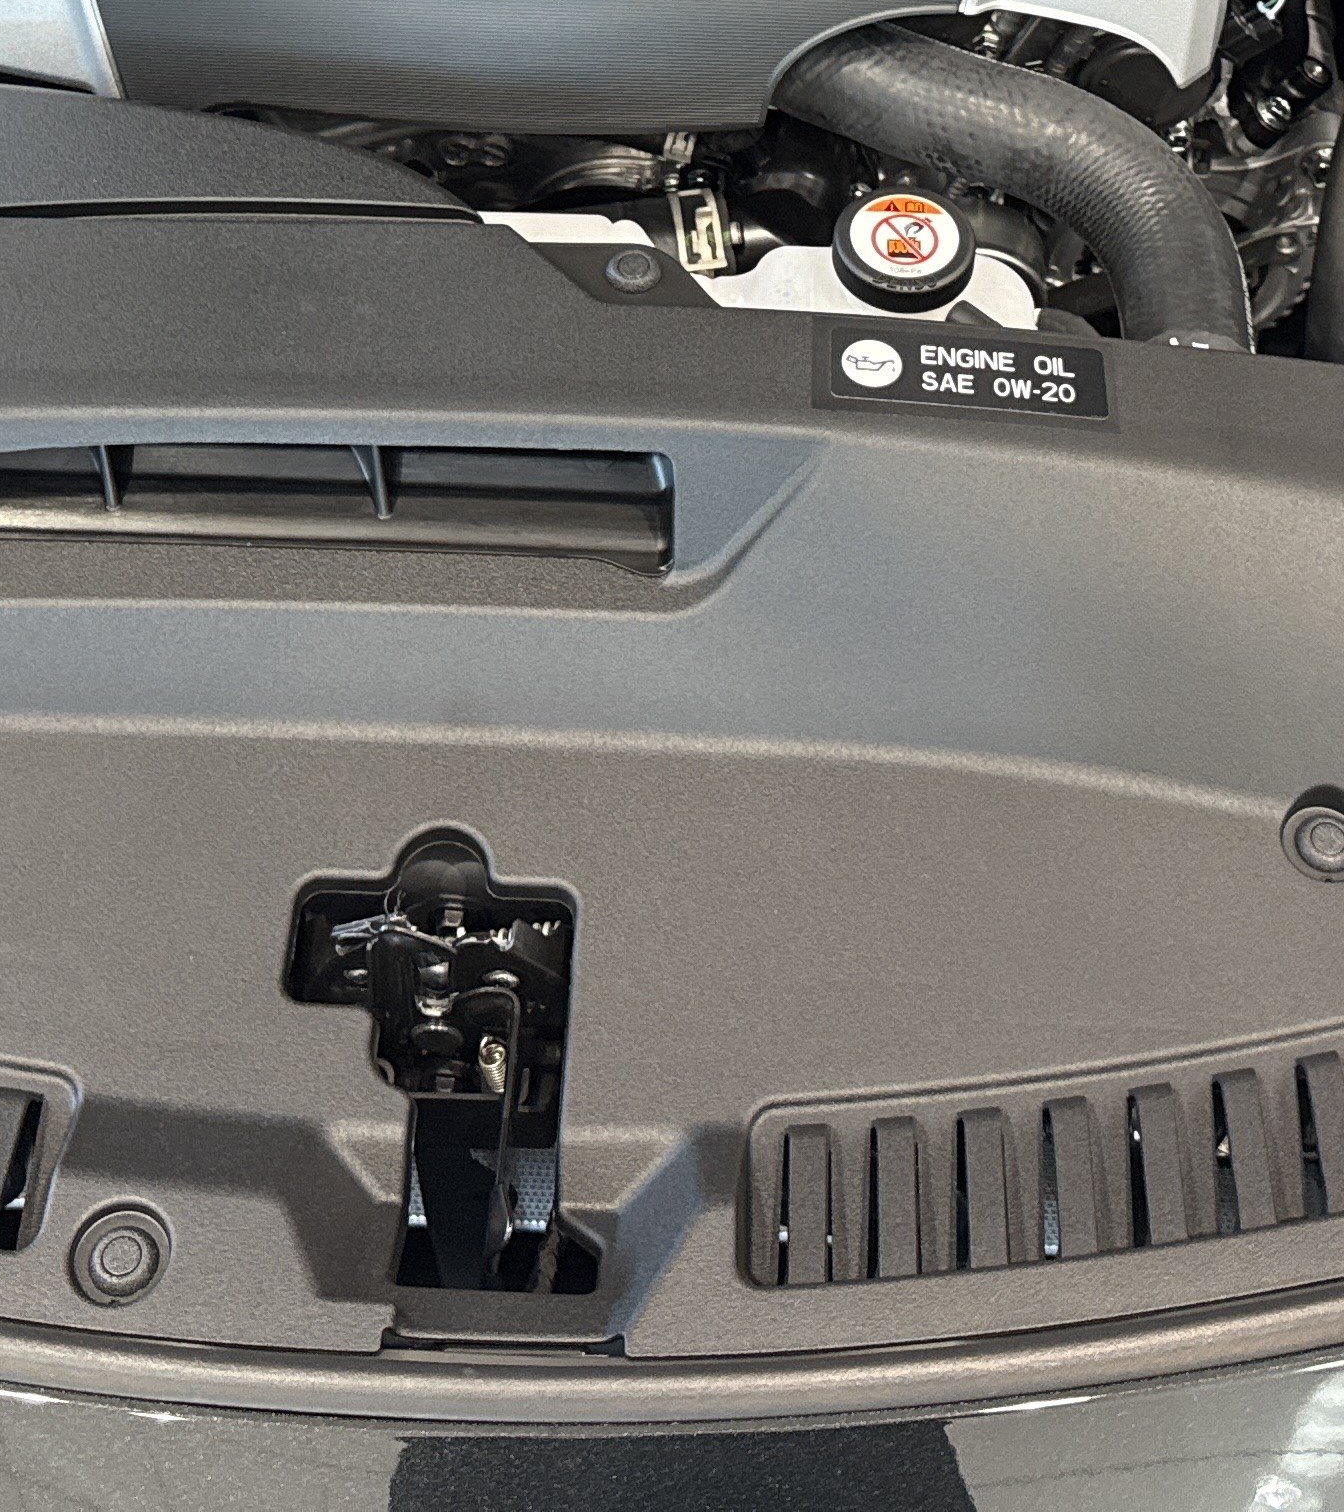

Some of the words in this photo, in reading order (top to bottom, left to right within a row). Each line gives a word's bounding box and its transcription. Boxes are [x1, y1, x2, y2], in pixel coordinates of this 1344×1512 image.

[920, 344, 1016, 372] ENGINE
[1033, 355, 1076, 379] OIL
[921, 372, 975, 395] SAE
[993, 377, 1077, 404] 0W-20
